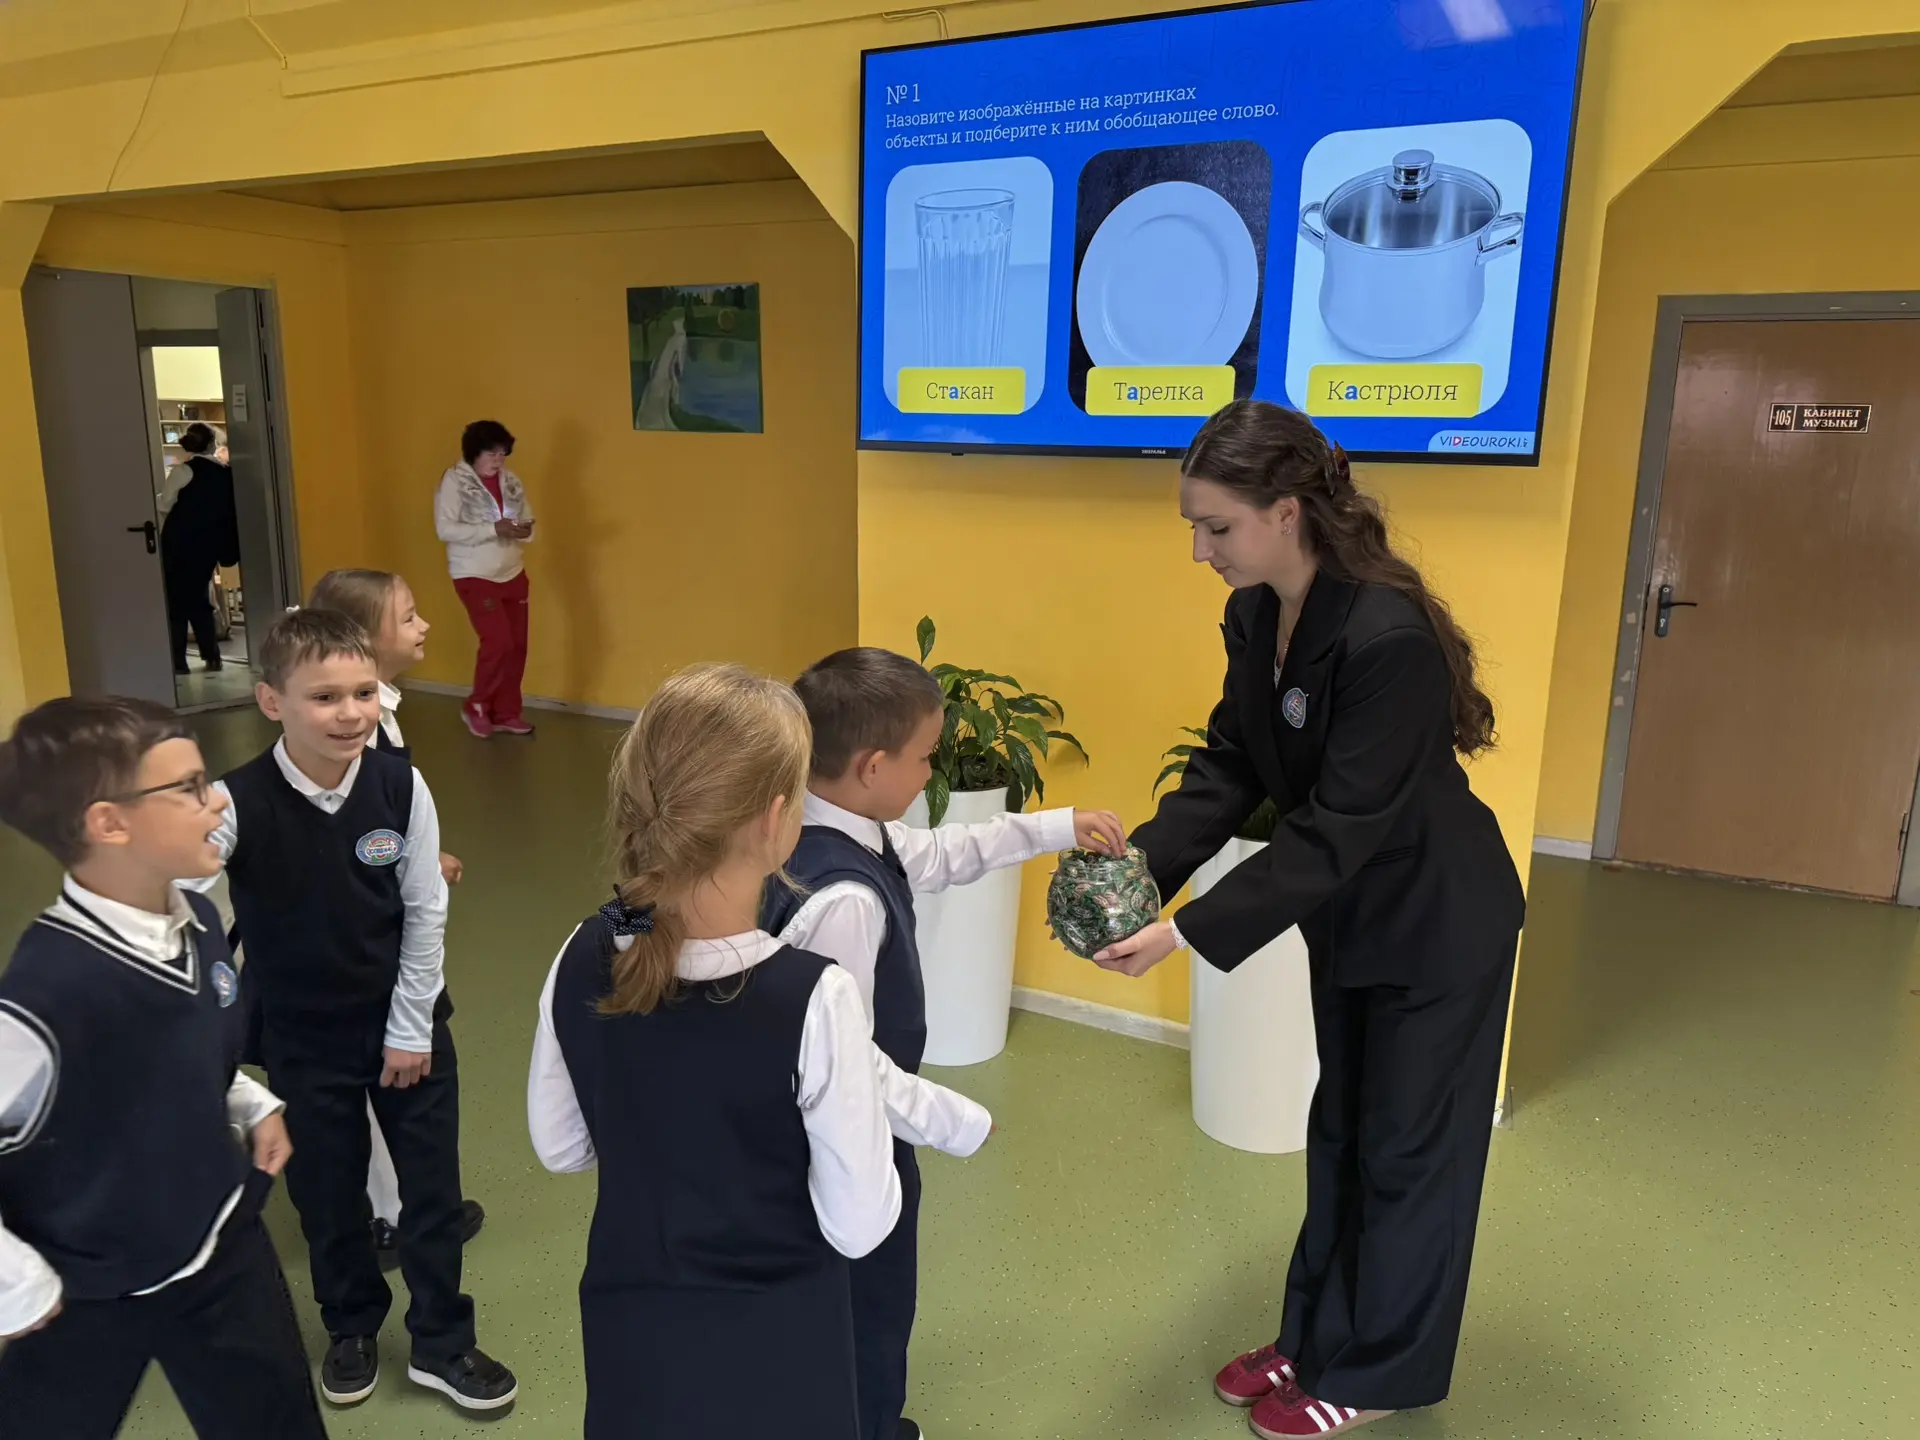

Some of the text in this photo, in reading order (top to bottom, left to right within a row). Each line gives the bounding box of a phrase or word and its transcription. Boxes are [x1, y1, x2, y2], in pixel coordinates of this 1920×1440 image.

[886, 83, 921, 105] № 1
[885, 87, 1197, 129] Назовите изображённые на картинках
[885, 103, 1279, 149] объекты и подберите к ним обобщающее слово.
[925, 382, 995, 401] Стакан
[1113, 382, 1204, 406] Тарелка
[1327, 380, 1459, 406] Кастрюля
[1774, 409, 1792, 426] 105
[1802, 419, 1859, 428] МУЗЫКИ
[1803, 408, 1862, 418] КАБИНЕТ
